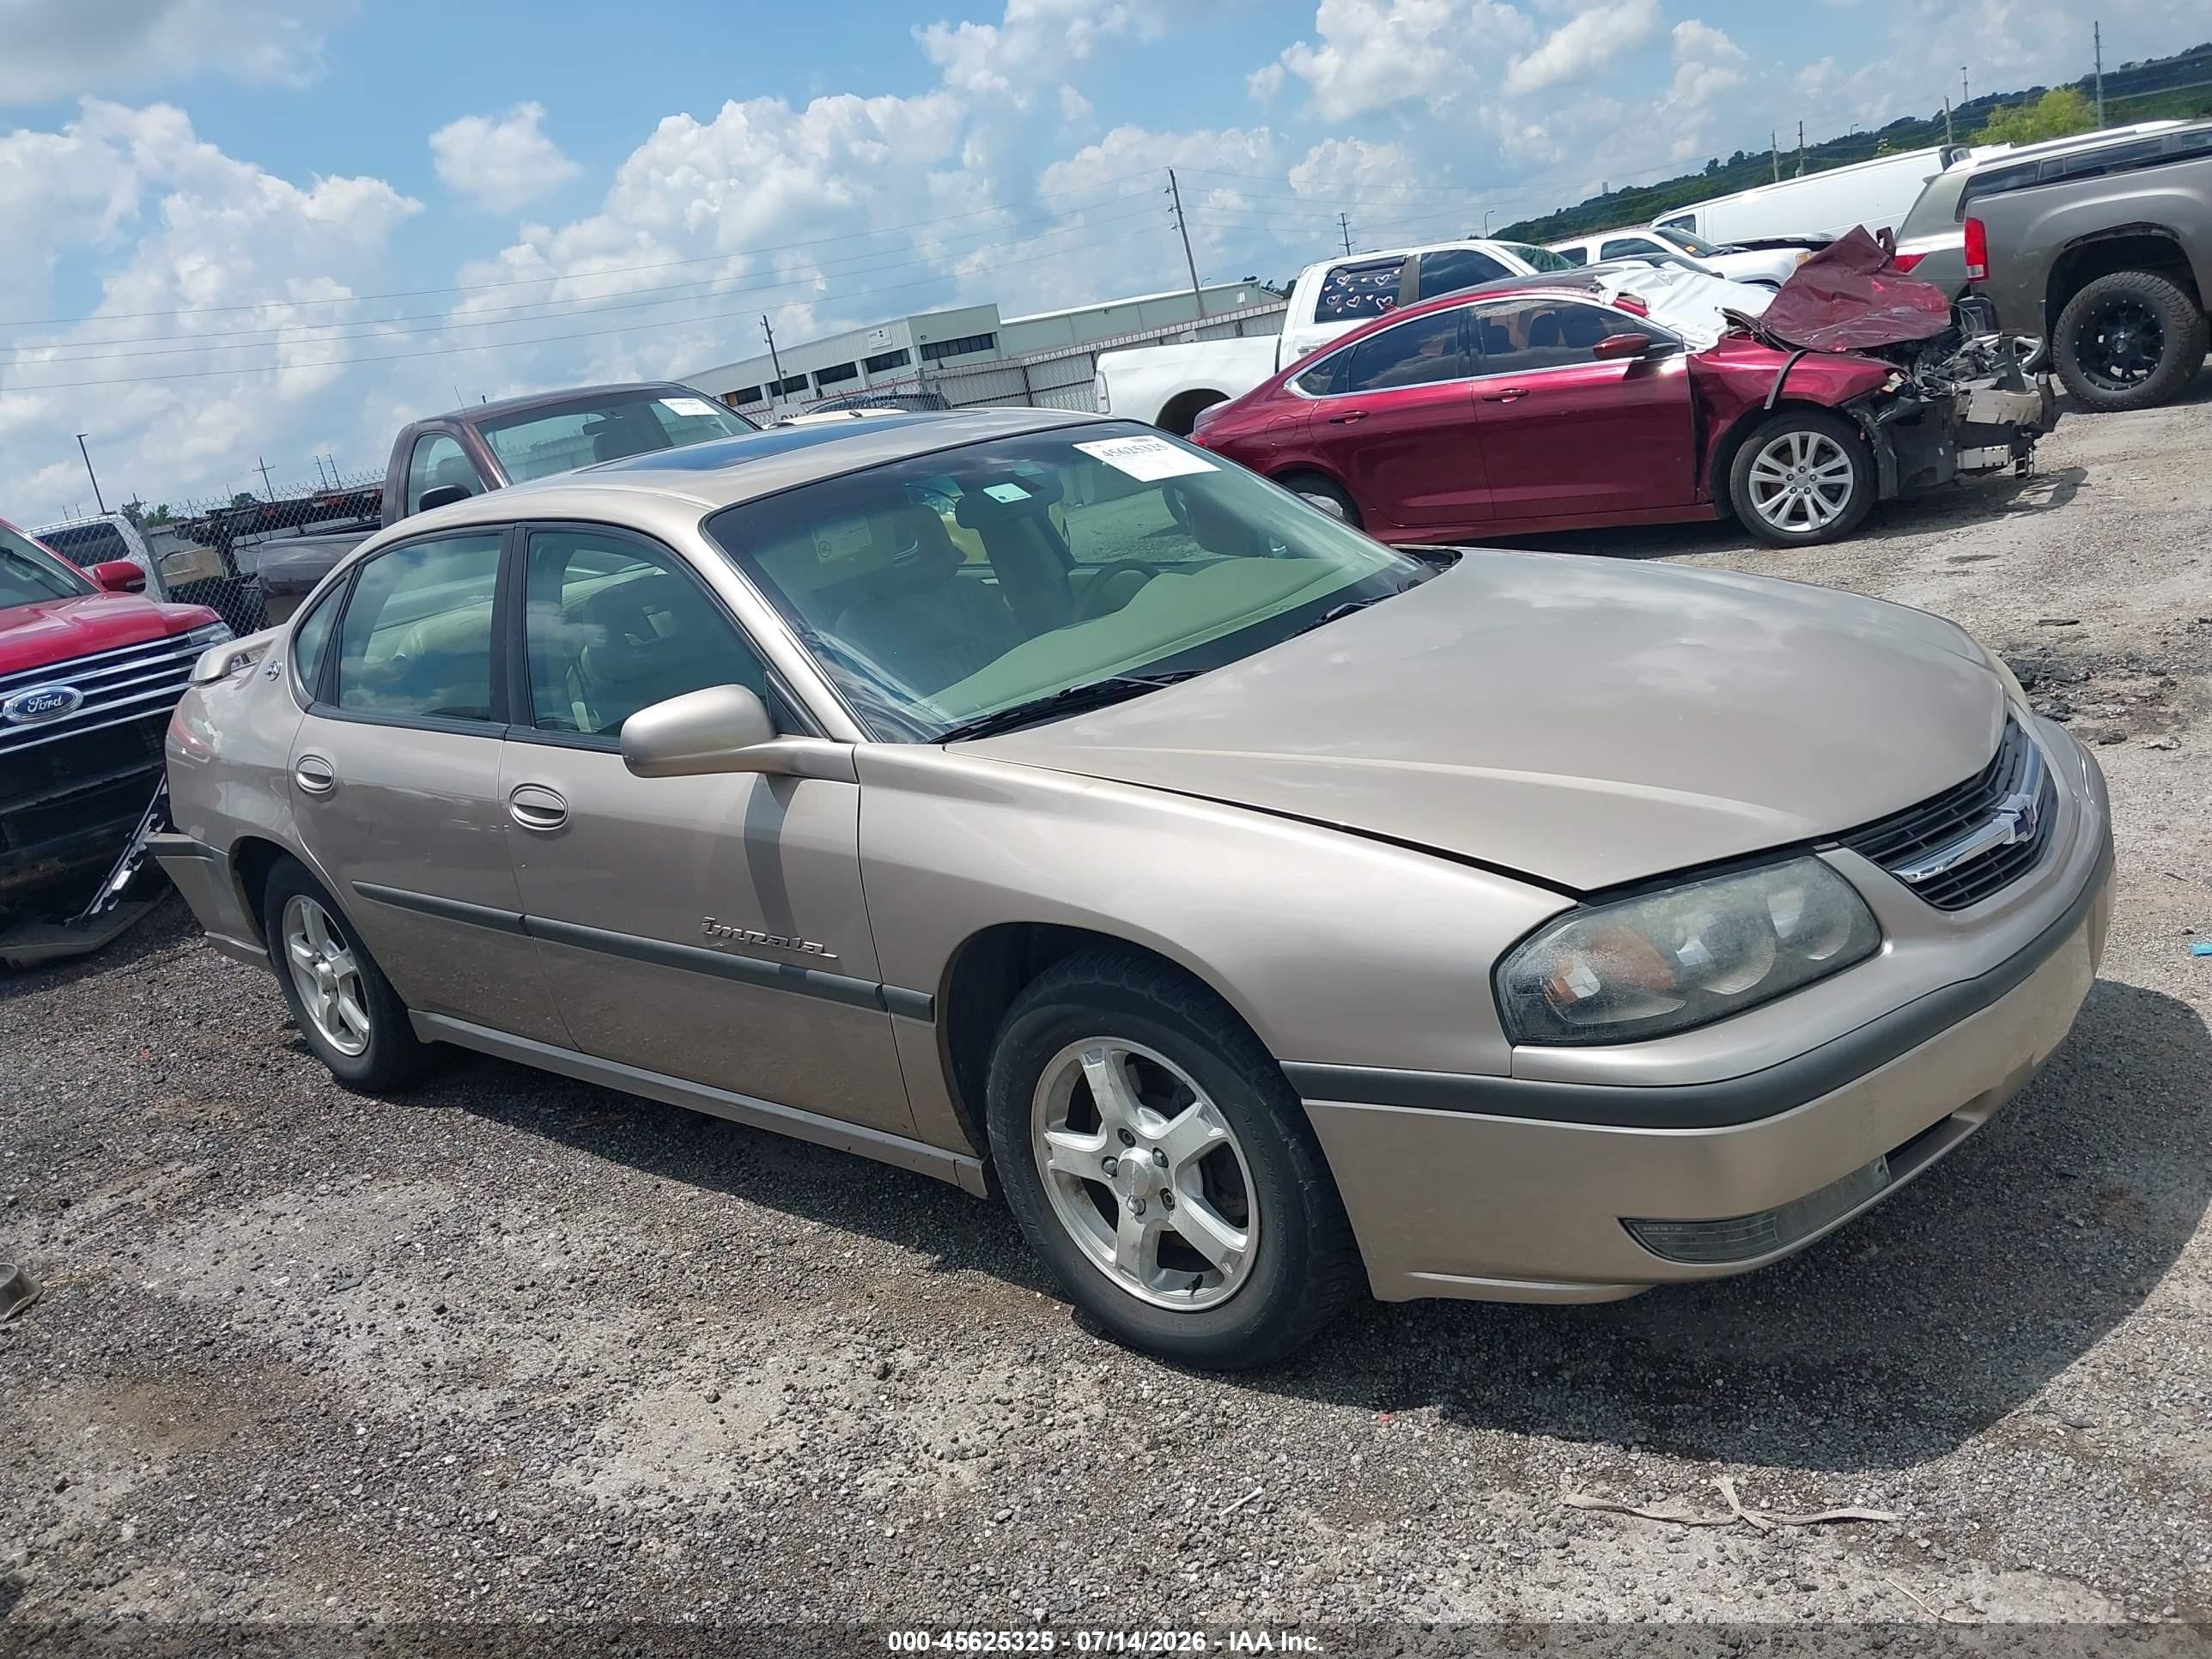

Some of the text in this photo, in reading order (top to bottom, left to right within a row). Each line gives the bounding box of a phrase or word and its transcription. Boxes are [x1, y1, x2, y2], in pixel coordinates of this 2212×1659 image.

[1102, 443, 1169, 457] 45625325
[27, 694, 64, 713] Ford
[700, 916, 838, 958] Impala
